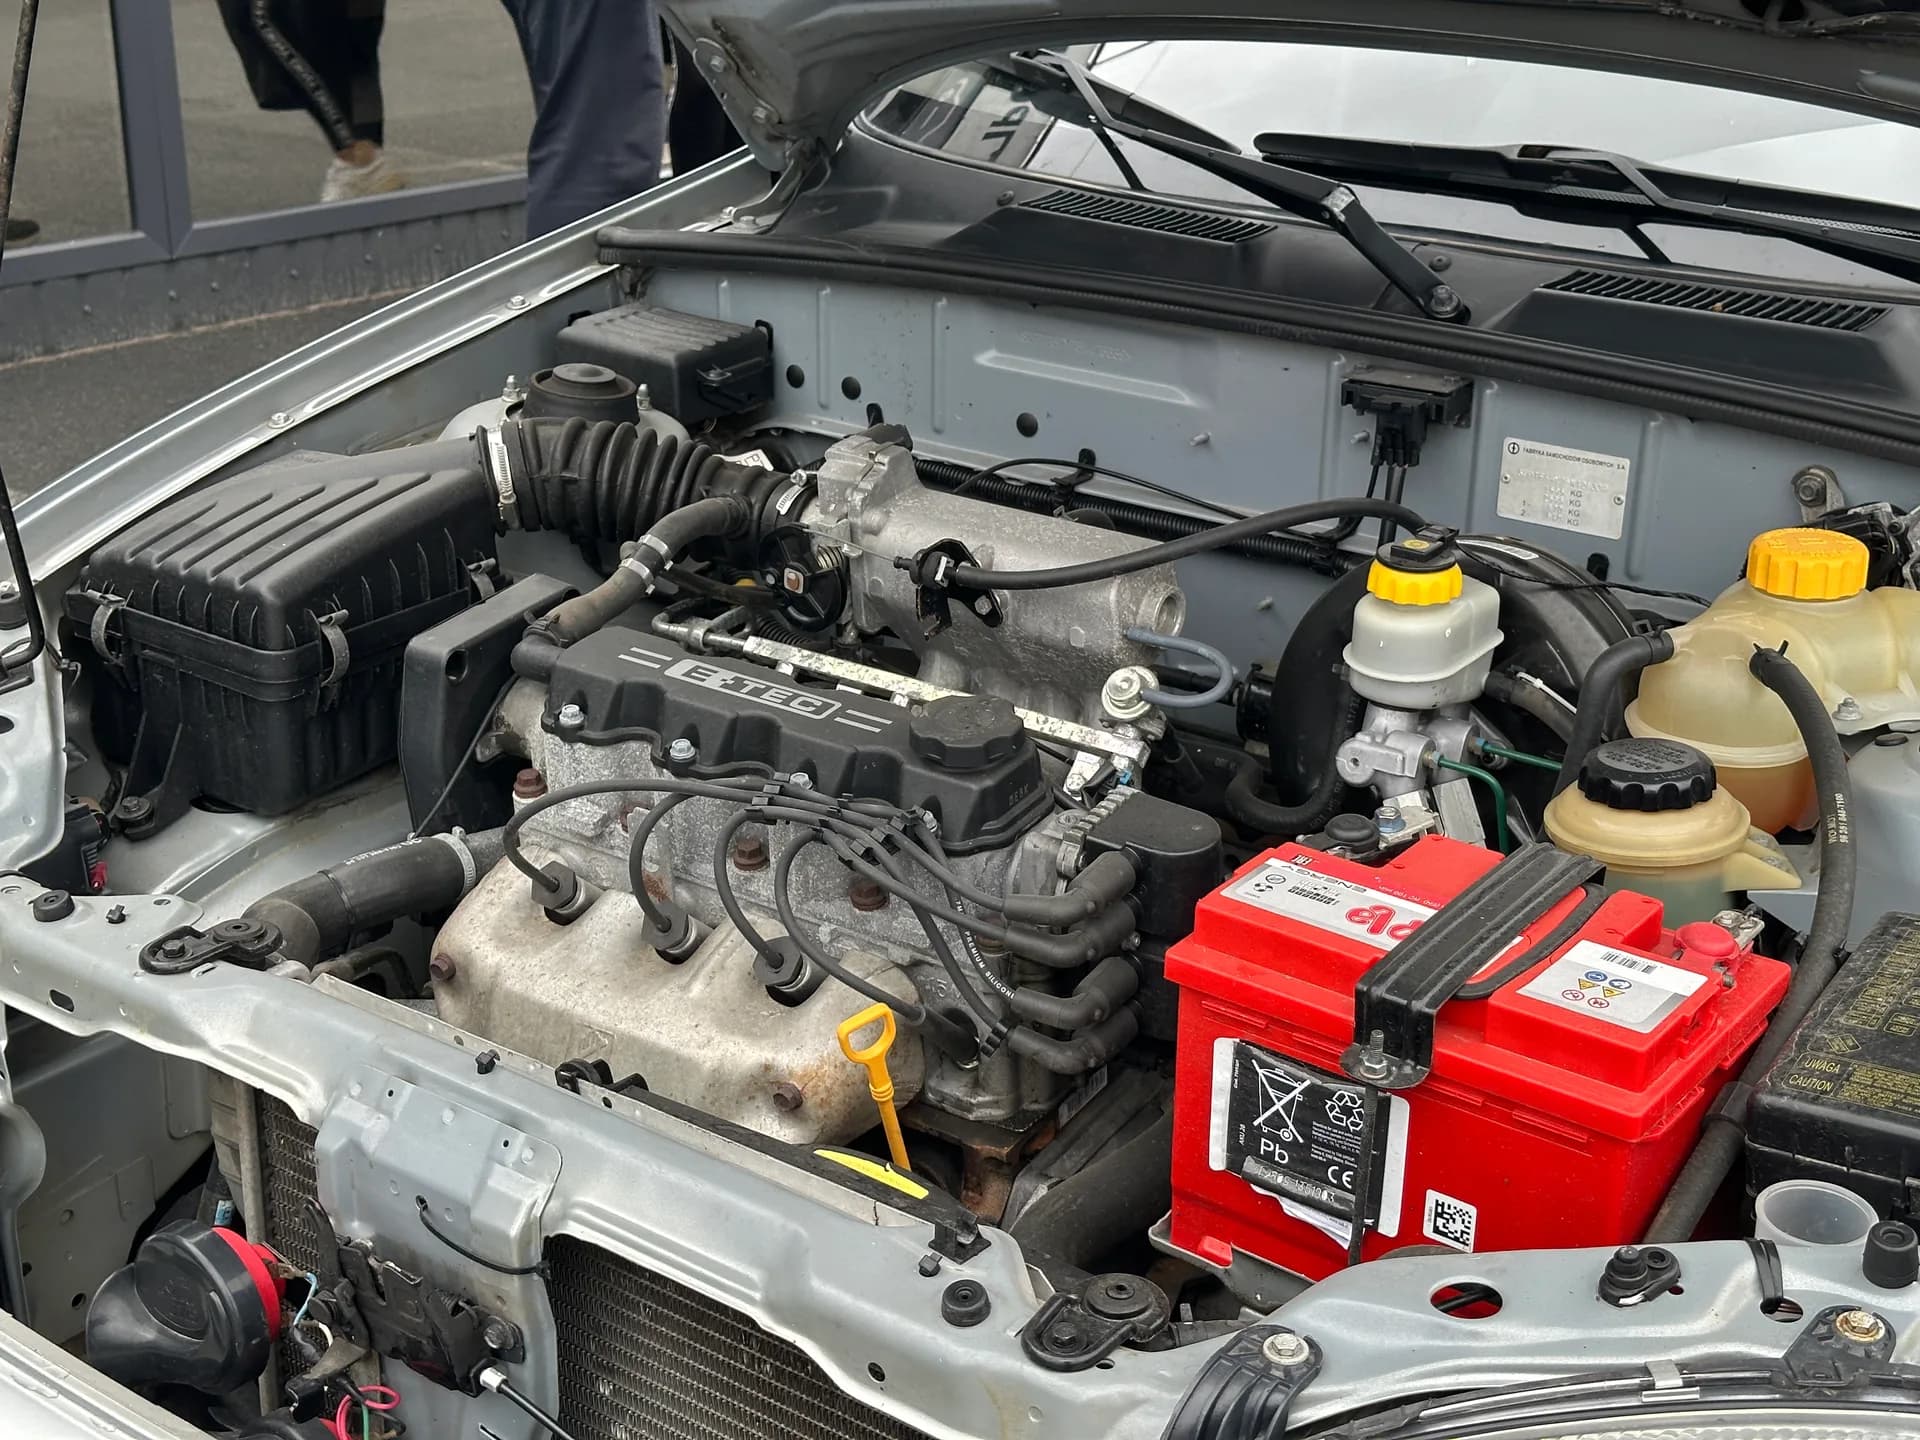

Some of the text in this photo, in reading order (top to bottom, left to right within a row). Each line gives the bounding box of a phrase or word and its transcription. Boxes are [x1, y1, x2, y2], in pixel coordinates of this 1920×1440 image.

[1281, 865, 1367, 894] ENERGY
[964, 930, 986, 969] PREMIUM
[1804, 1058, 1841, 1074] UWAGA
[1789, 1074, 1834, 1091] CAUTION
[1260, 1137, 1289, 1164] Pb
[1327, 1166, 1354, 1189] CE
